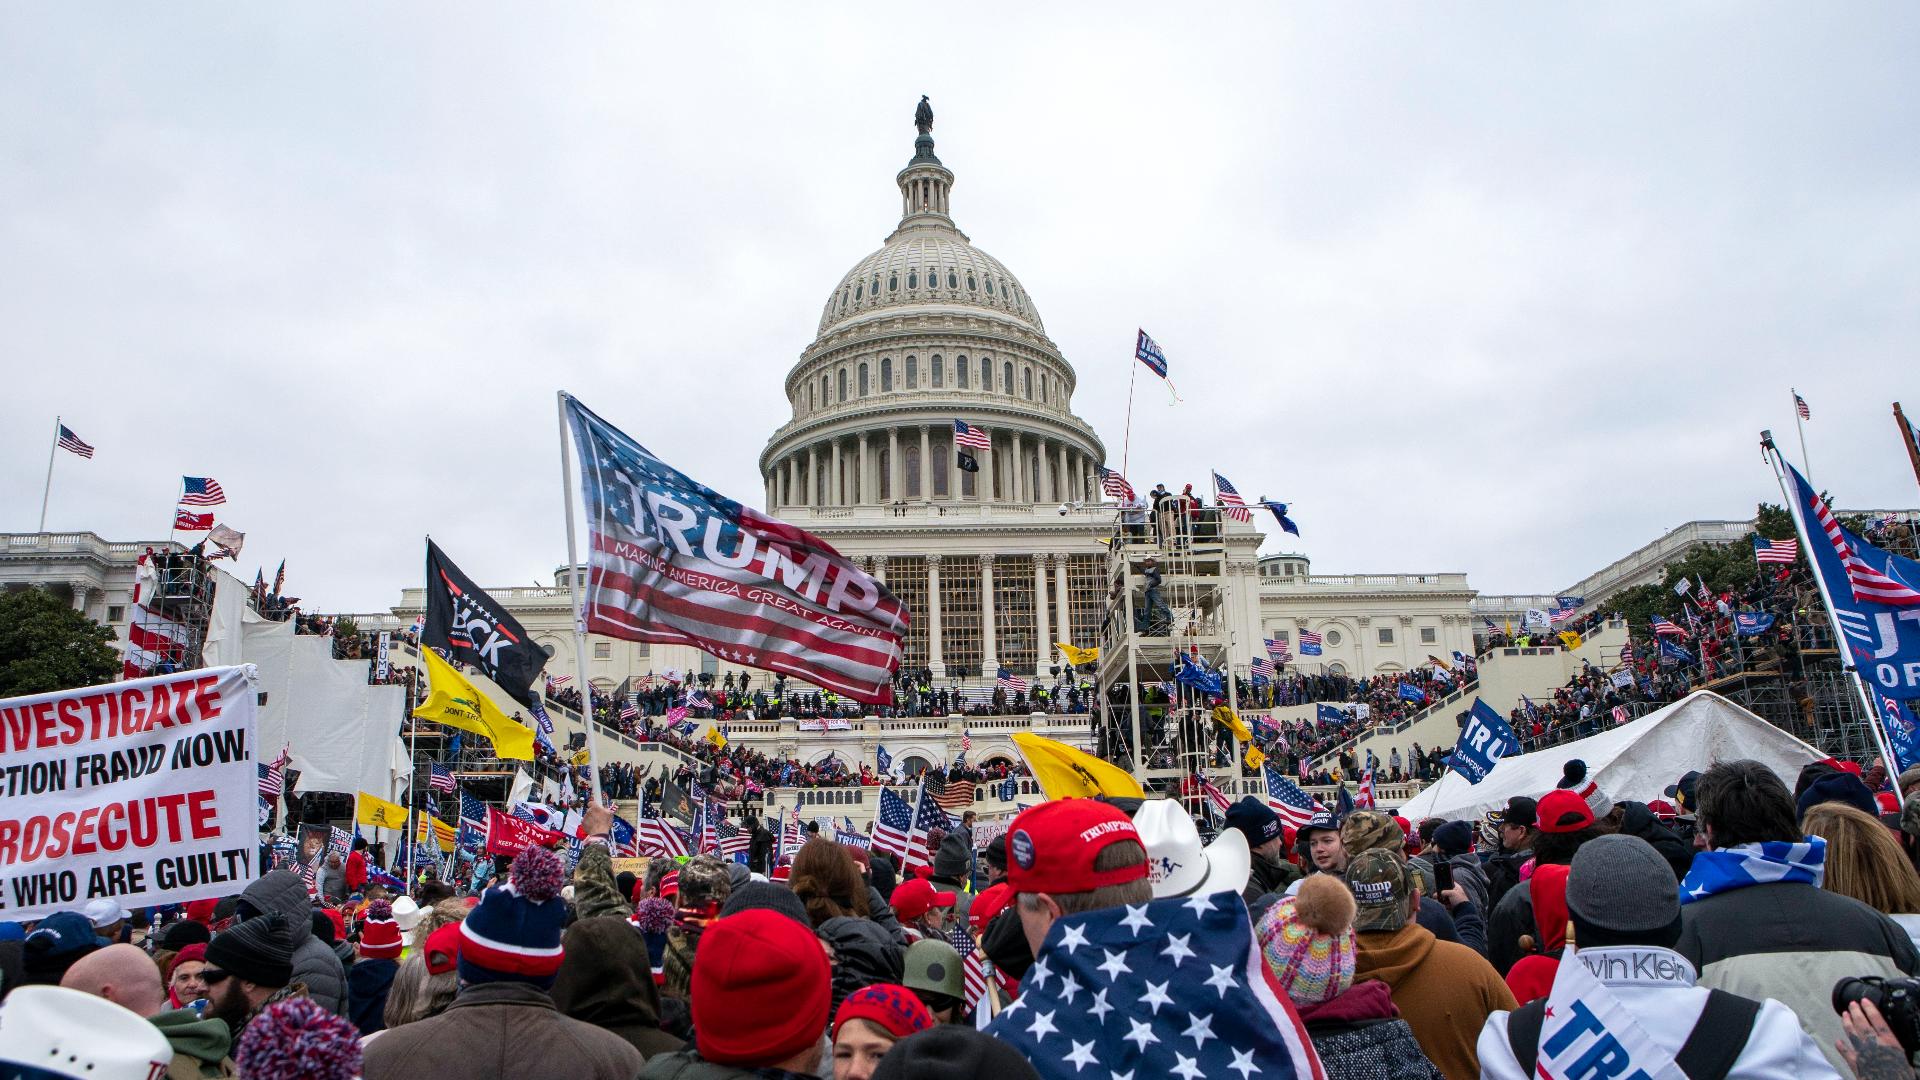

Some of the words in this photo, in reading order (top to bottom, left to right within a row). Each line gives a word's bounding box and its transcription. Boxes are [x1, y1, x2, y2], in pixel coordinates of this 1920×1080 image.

[615, 469, 879, 613] TRUMP
[615, 542, 666, 573] MAKING
[669, 568, 740, 597] AMERICA
[747, 589, 813, 617] GREAT
[816, 616, 882, 638] AGAIN!
[378, 633, 388, 678] TRUMP
[444, 706, 465, 717] DONT
[538, 706, 552, 733] TRUMP
[76, 743, 166, 788] FRAUD
[171, 728, 249, 770] NOW.
[837, 833, 870, 848] TRUMP
[1081, 821, 1120, 843] TRUMP
[12, 870, 77, 908] WHO
[87, 862, 146, 899] ARE
[156, 848, 249, 890] GUILTY
[1352, 880, 1392, 893] Trump
[1633, 953, 1685, 982] Klein
